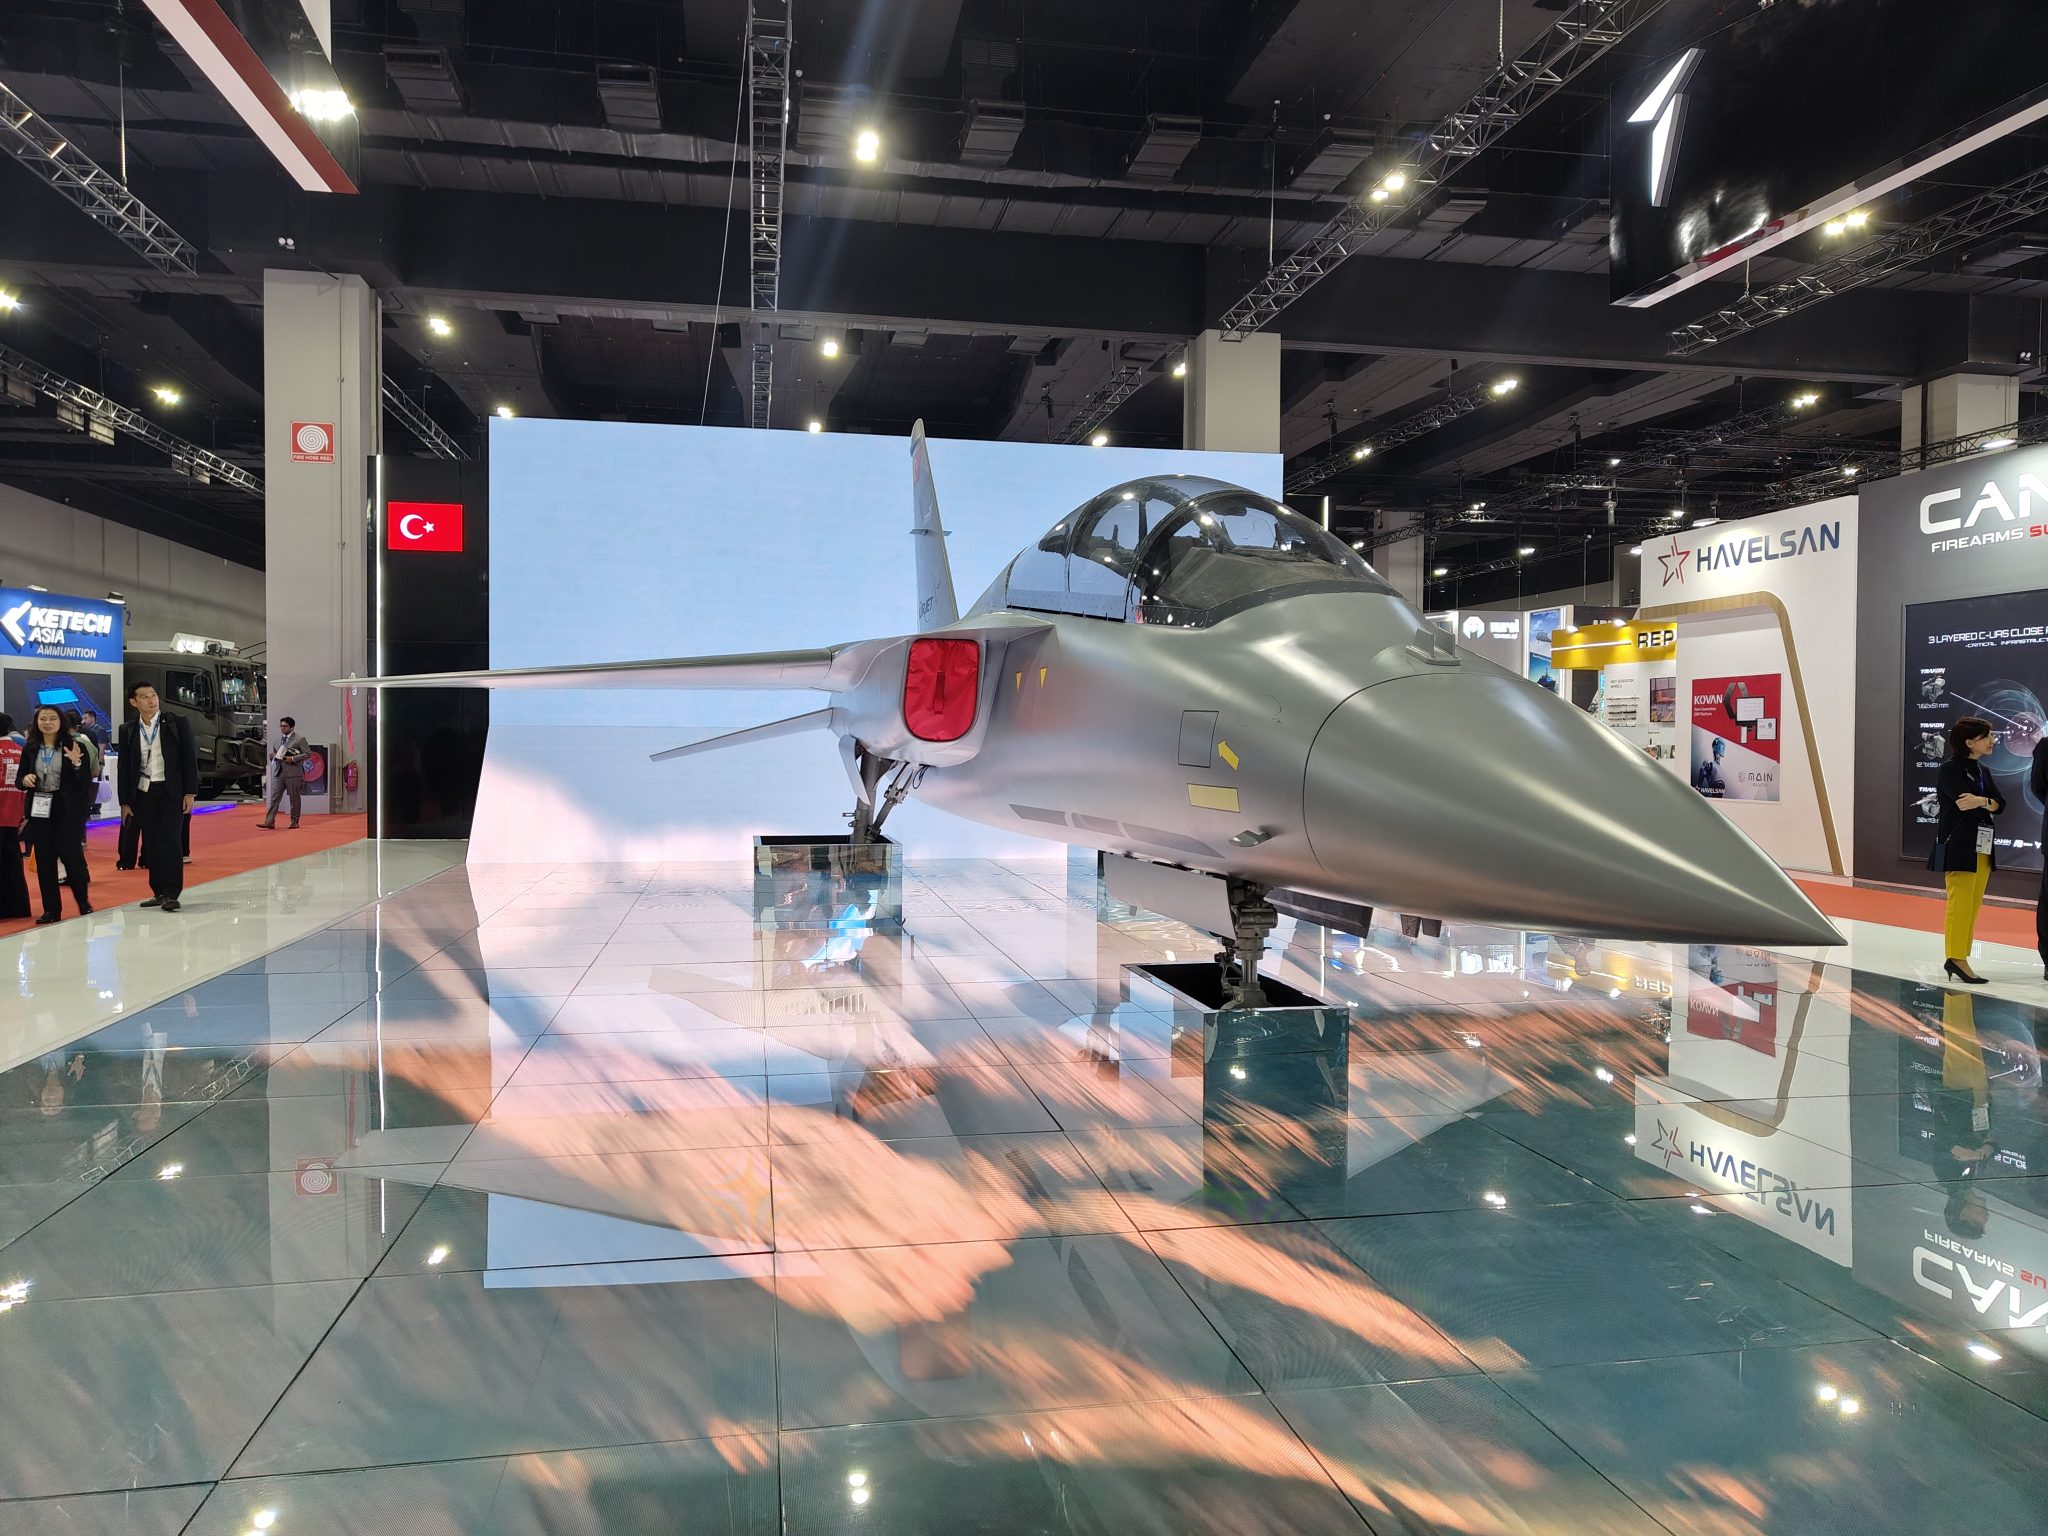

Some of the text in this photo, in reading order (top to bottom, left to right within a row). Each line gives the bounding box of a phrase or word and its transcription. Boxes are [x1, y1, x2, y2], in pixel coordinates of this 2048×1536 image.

[1697, 521, 1840, 572] HAVELSAN
[1931, 528, 2024, 553] FIREARMS
[28, 607, 112, 634] KETECH
[28, 627, 65, 645] ASIA
[1637, 629, 1674, 649] REP
[1928, 626, 2044, 644] 3 LAYERED C-UAS CLOSE
[37, 645, 97, 659] AMMUNITION
[1694, 694, 1723, 705] KOVAN
